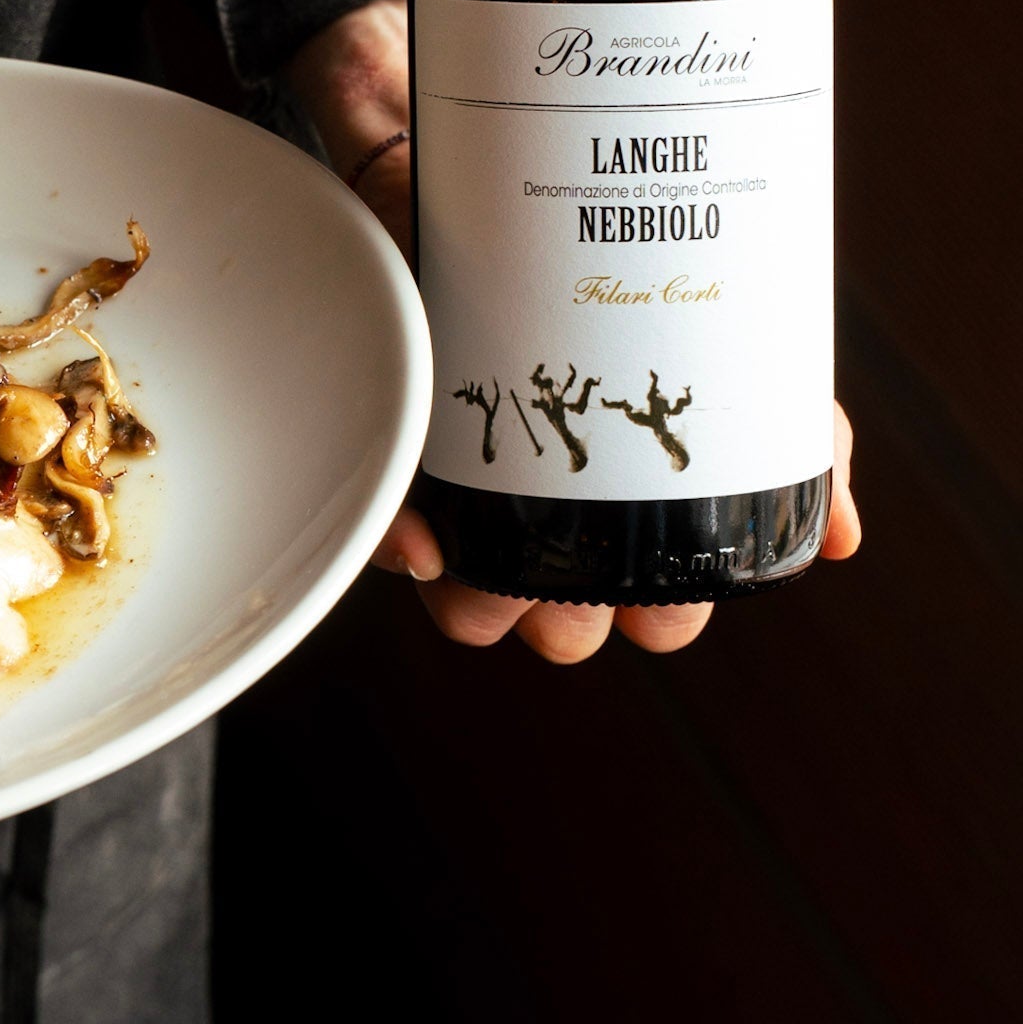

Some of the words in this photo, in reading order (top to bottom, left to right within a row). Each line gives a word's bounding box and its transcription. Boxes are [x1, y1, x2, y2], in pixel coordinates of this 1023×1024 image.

[534, 26, 757, 77] Brandini
[610, 36, 680, 49] AGRICOLA
[698, 77, 711, 88] LA
[714, 75, 747, 87] MORRA
[590, 135, 708, 174] LANGHE
[524, 181, 629, 198] Denominazione
[633, 182, 645, 198] di
[650, 181, 698, 200] Origine
[702, 176, 767, 196] Controllata
[577, 203, 720, 243] NEBBIOLO
[573, 275, 656, 305] Filari
[659, 274, 725, 303] Corti
